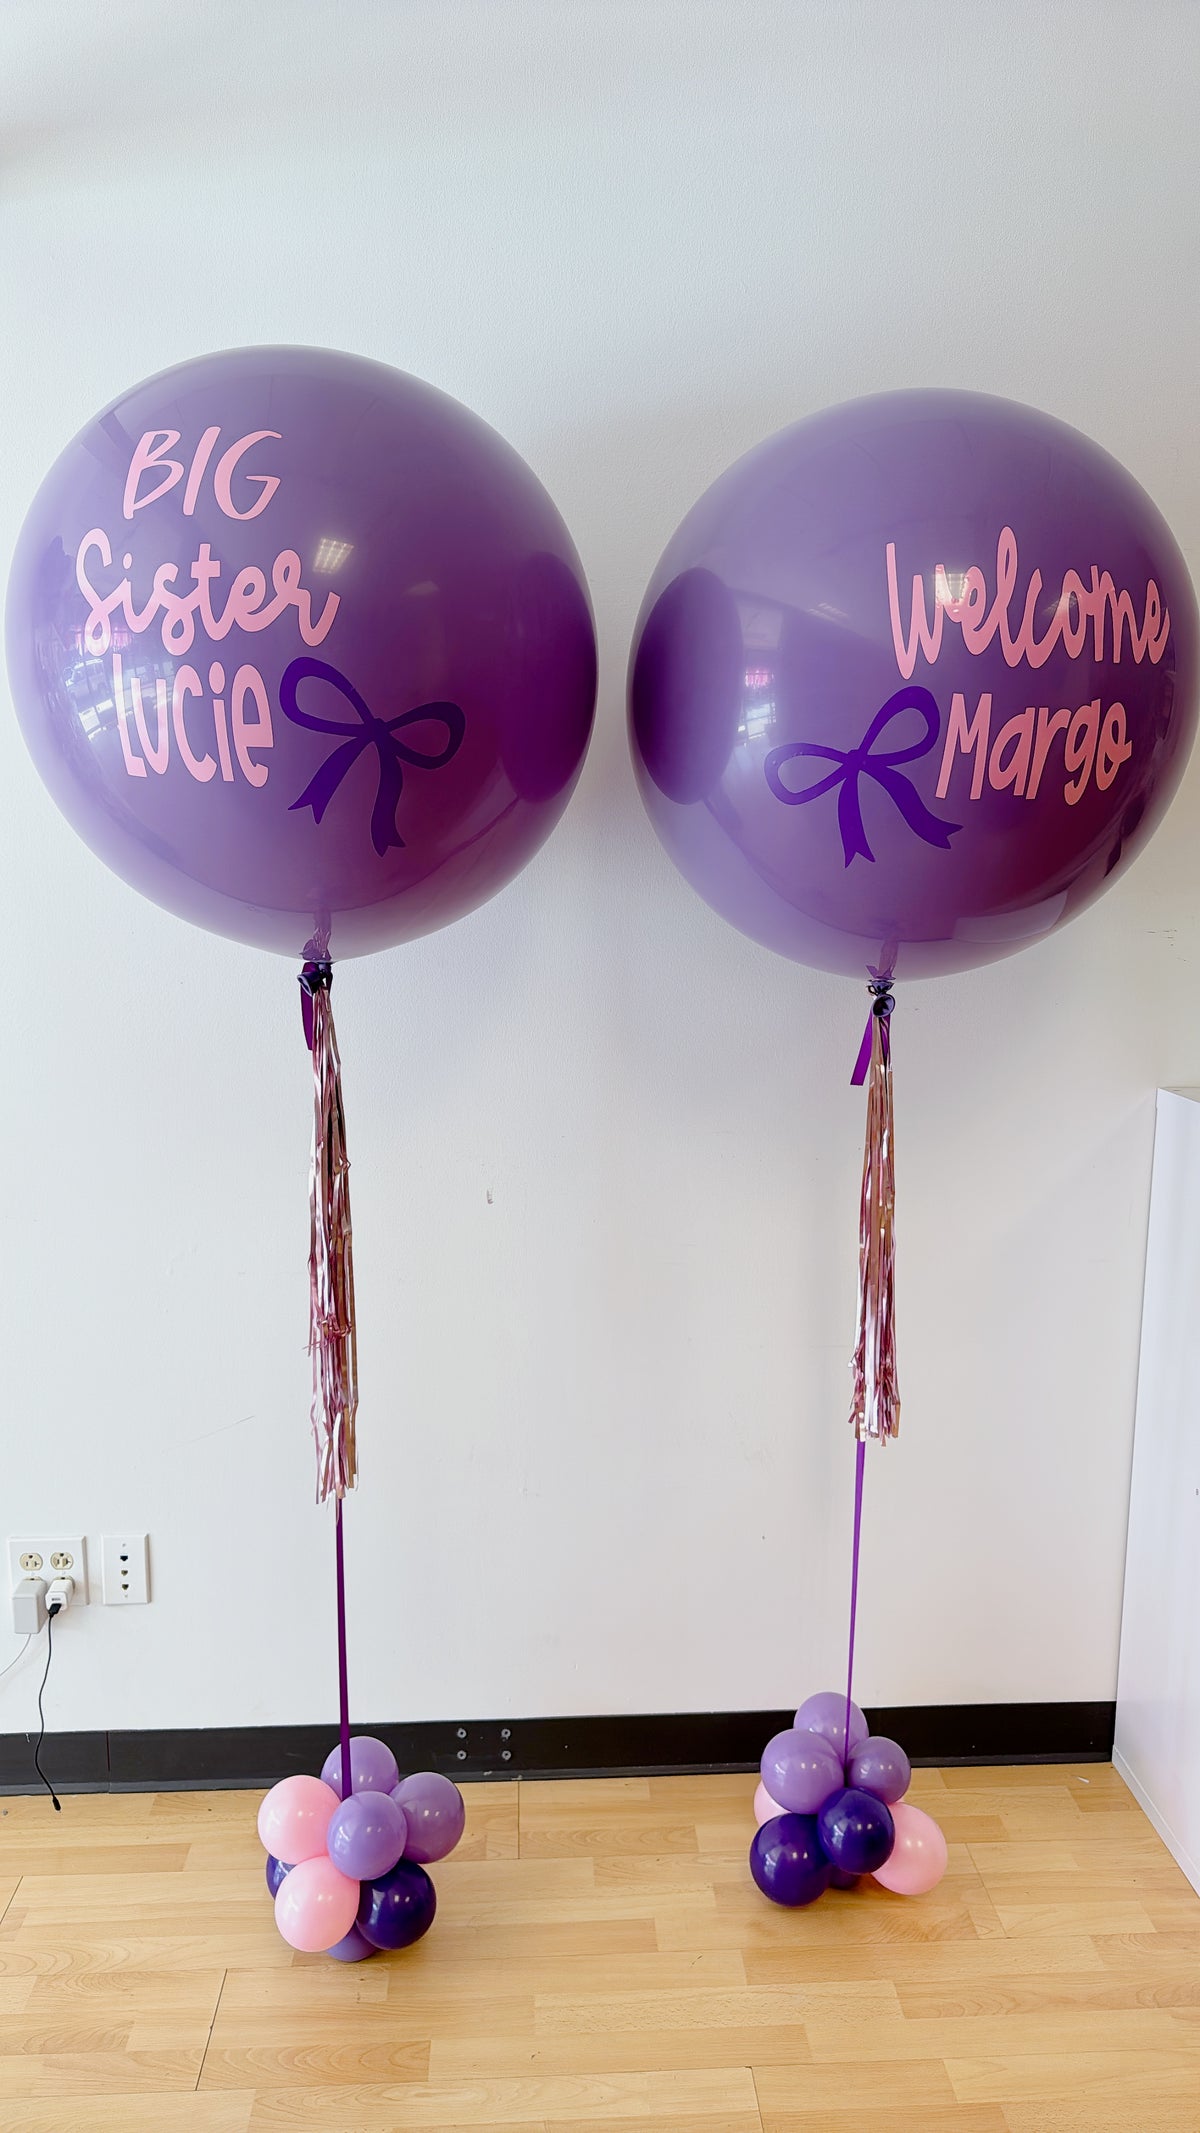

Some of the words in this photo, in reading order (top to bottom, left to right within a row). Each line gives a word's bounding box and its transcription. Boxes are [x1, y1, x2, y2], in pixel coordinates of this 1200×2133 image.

[123, 426, 282, 520] BIG
[76, 528, 341, 656] Sister
[886, 526, 1170, 680] Welcome
[112, 653, 274, 788] Lucie
[936, 692, 1132, 806] Margo
